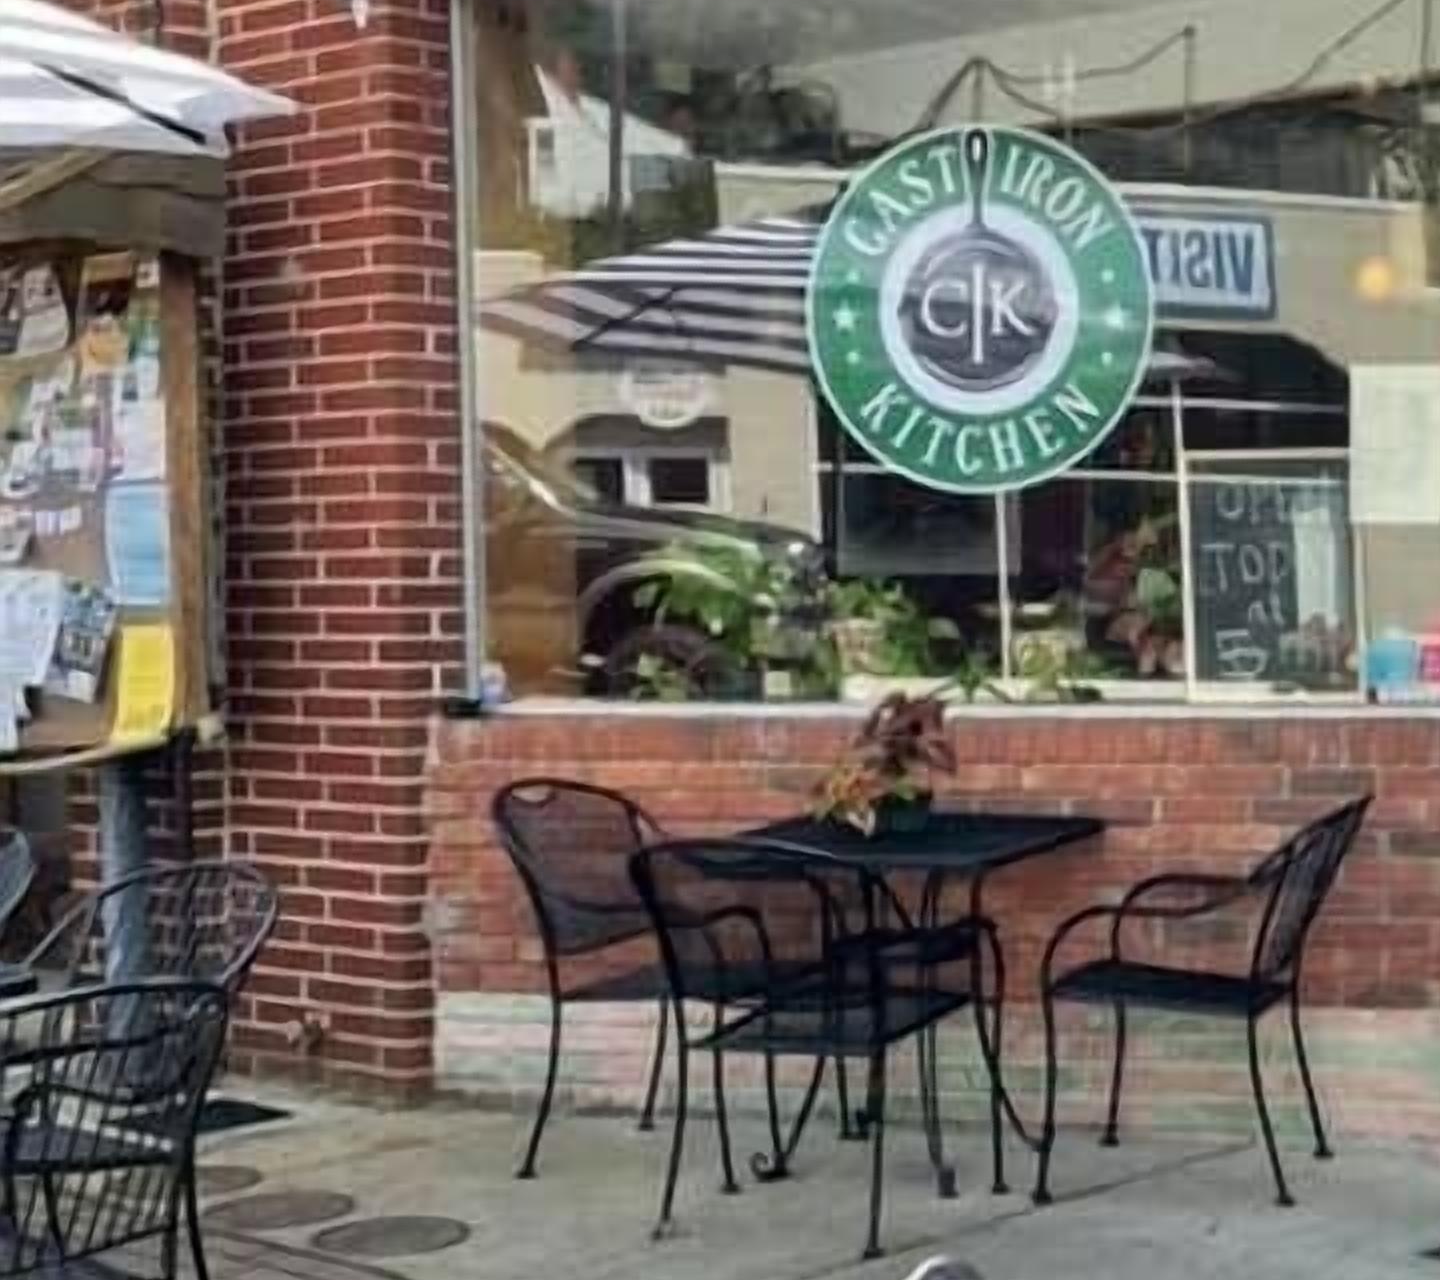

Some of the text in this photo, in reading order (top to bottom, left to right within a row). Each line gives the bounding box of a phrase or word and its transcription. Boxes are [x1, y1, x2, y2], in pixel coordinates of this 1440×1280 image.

[843, 145, 1114, 258] CAST IRON
[860, 382, 1101, 475] KITCHEN
